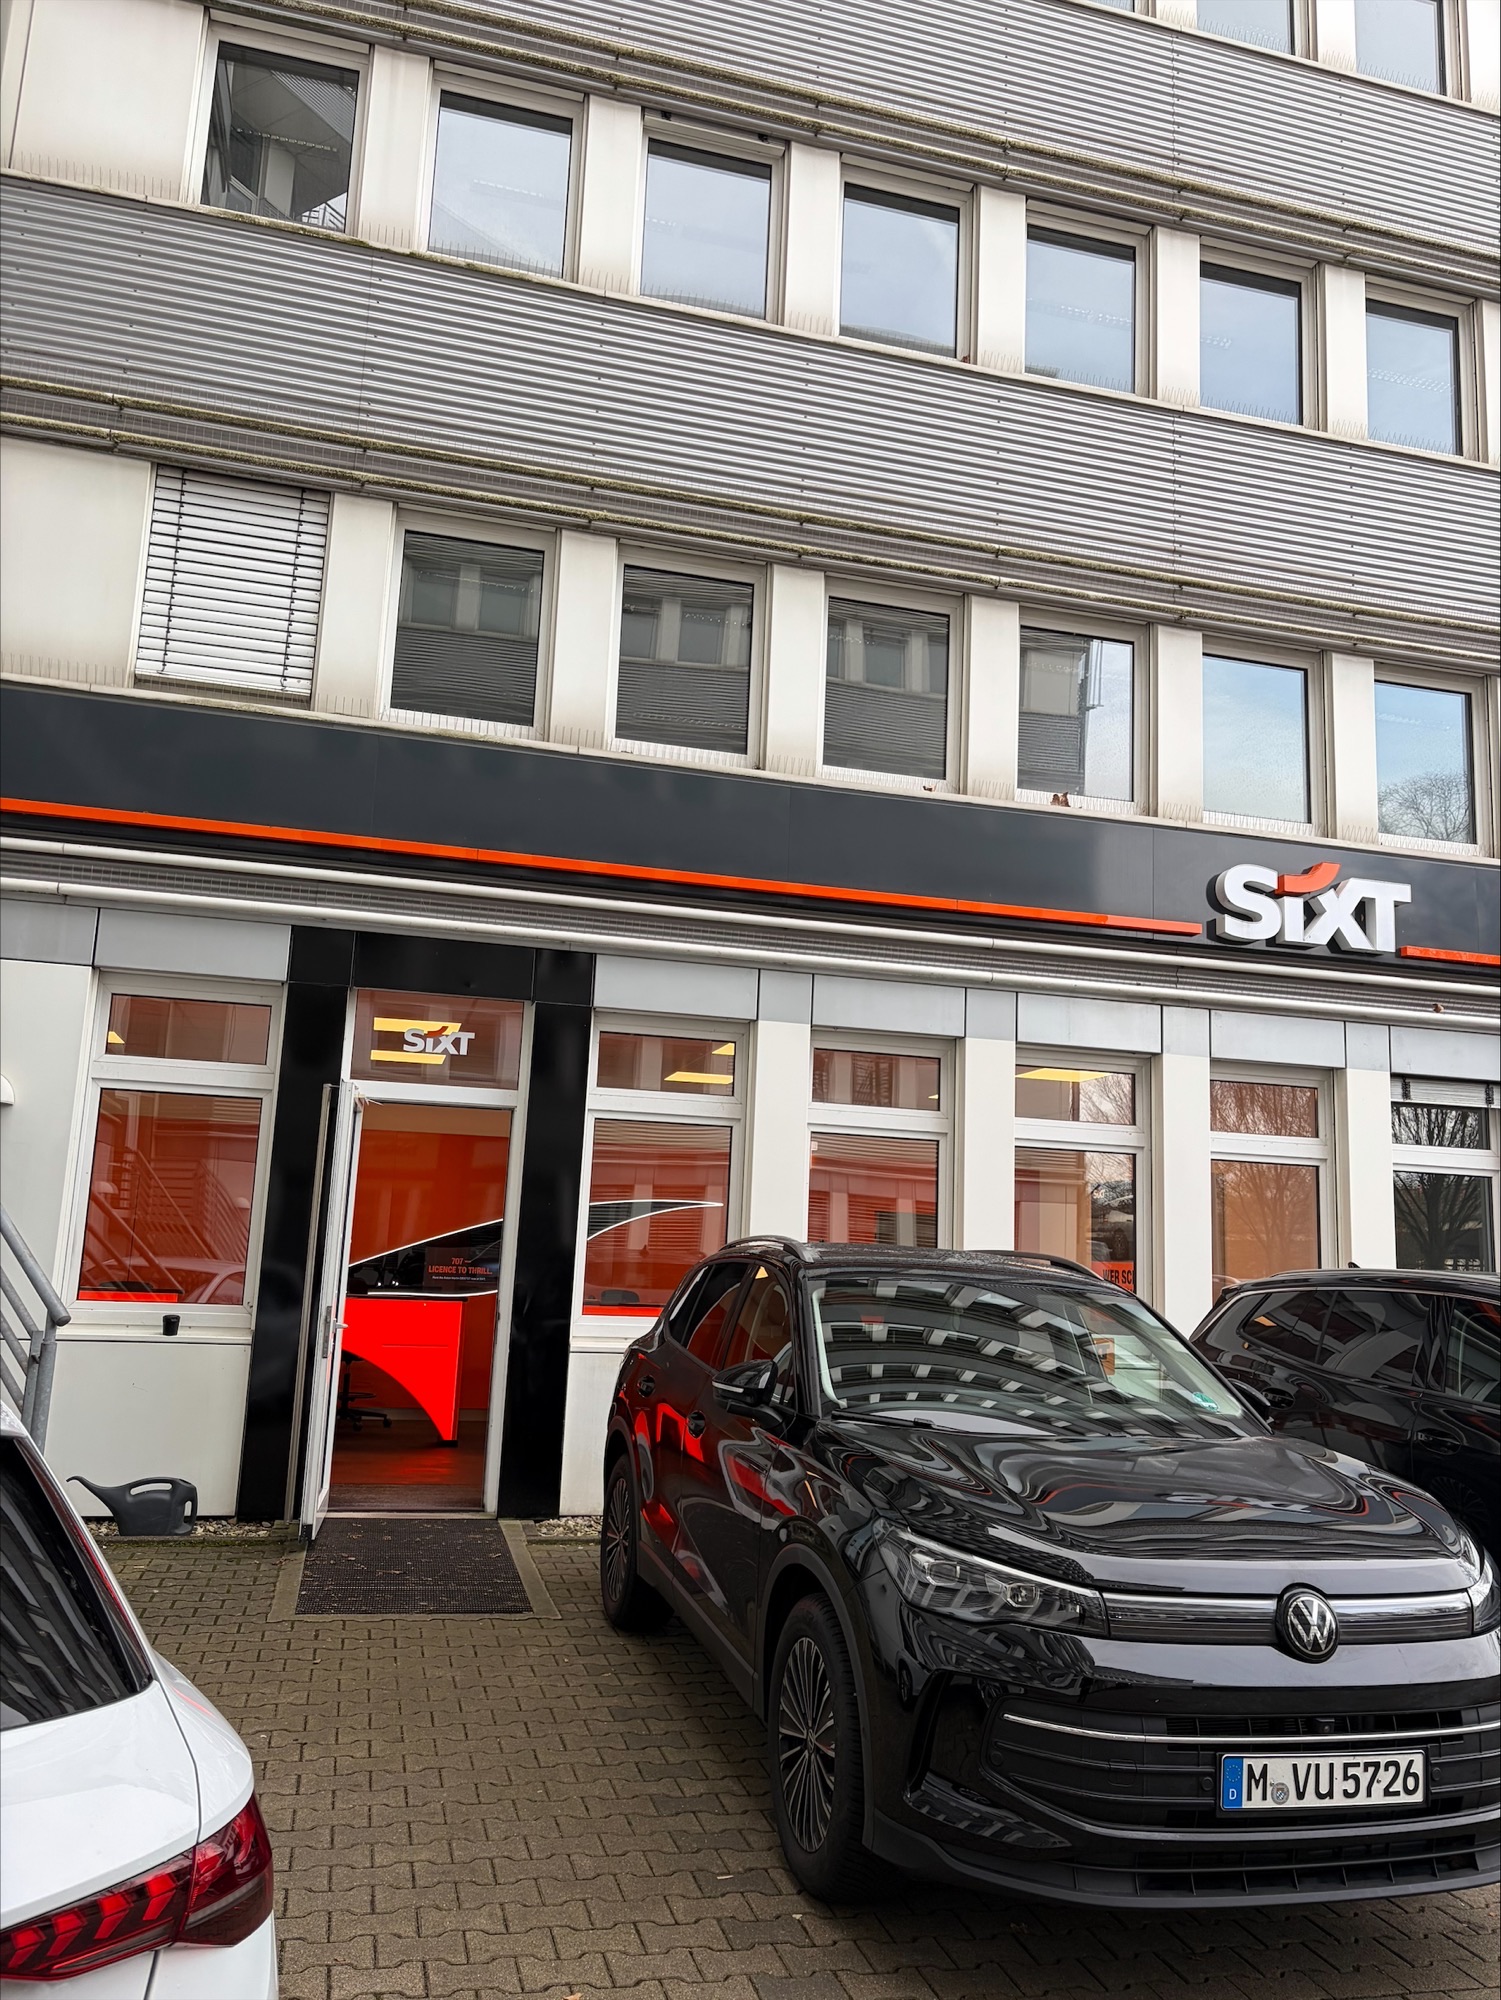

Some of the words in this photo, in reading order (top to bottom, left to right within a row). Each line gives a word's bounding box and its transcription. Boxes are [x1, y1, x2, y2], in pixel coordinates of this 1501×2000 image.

[428, 1265, 457, 1274] LICENCE
[458, 1266, 467, 1274] TO
[1121, 1269, 1135, 1285] SC
[1246, 1763, 1268, 1802] M
[1228, 1788, 1237, 1801] D
